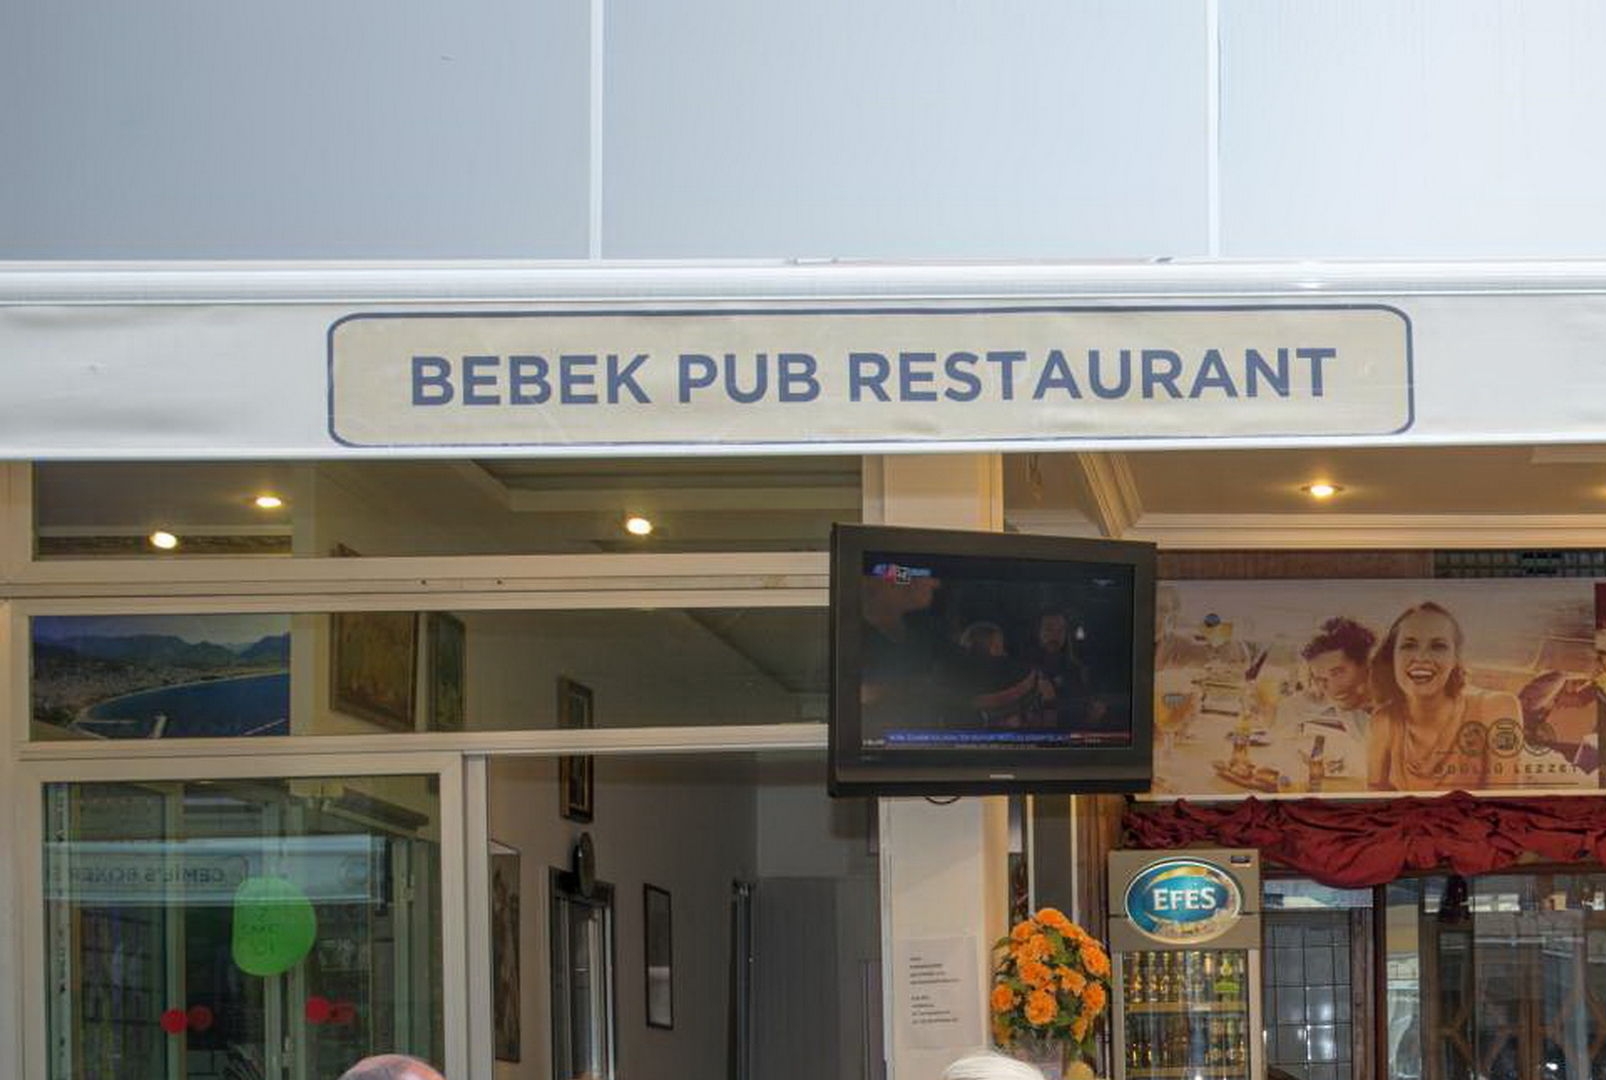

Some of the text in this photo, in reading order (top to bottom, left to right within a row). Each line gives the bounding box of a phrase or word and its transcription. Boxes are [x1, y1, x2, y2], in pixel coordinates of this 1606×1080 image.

[411, 348, 1336, 406] BEBEK PUB RESTAURANT
[1152, 887, 1216, 910] EFES
